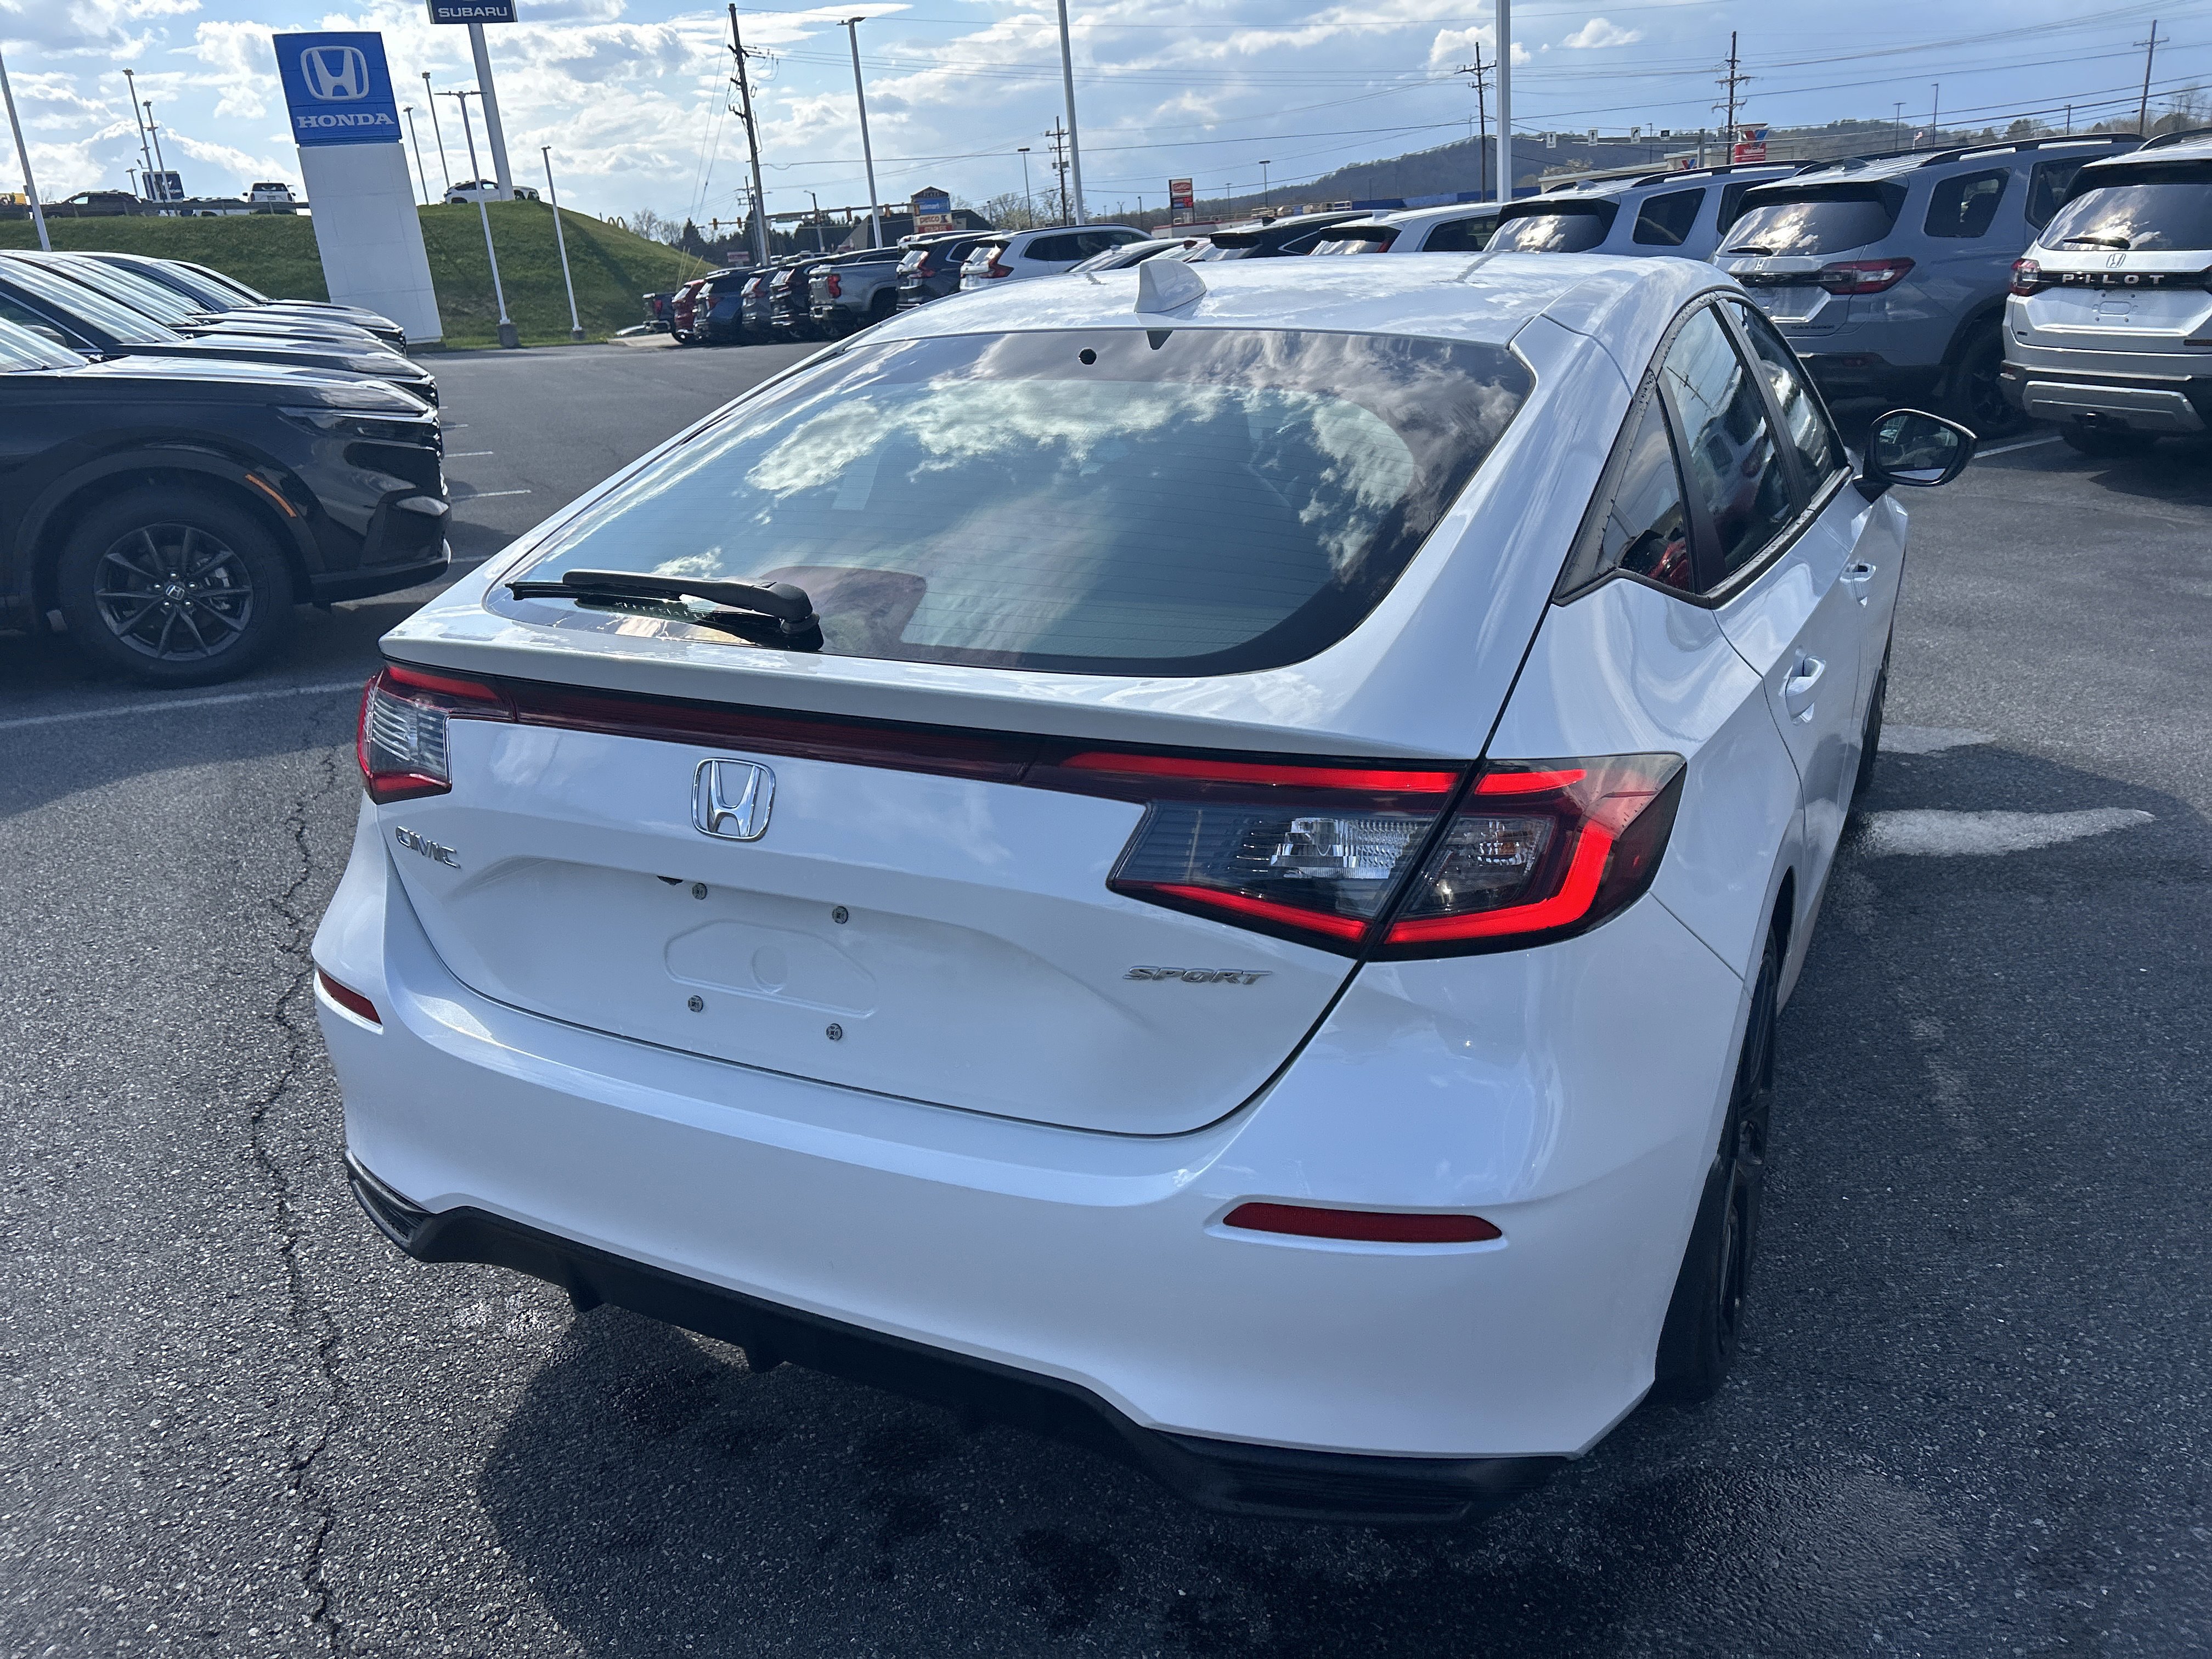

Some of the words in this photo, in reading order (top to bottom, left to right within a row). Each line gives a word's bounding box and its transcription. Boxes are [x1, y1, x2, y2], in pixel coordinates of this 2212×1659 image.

[438, 7, 508, 17] SUBARU
[297, 113, 395, 129] HONDA
[2062, 273, 2165, 284] PILOT
[396, 826, 461, 869] CIVIC
[1122, 965, 1273, 985] SPORT
